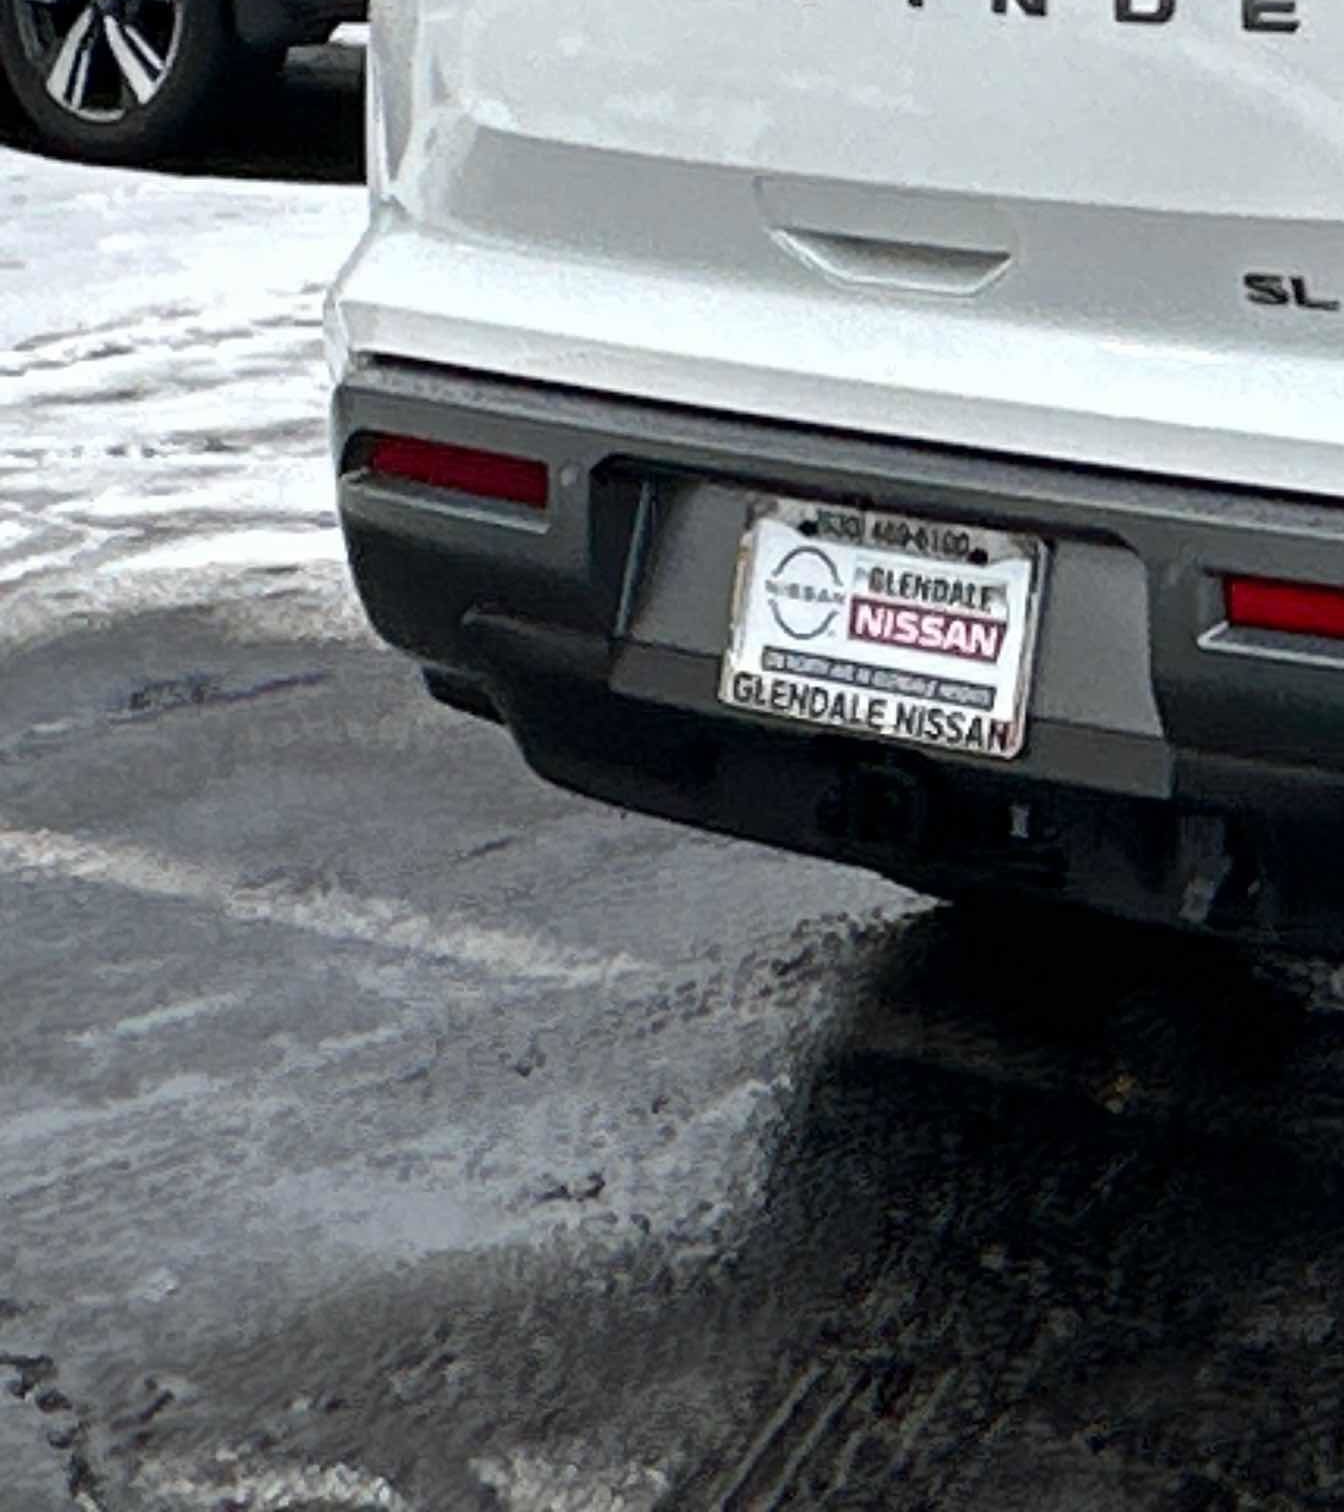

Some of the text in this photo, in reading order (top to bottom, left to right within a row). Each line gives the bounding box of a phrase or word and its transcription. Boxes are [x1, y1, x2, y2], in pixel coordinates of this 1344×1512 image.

[1243, 273, 1341, 311] SL
[765, 577, 847, 605] NISSAN
[868, 566, 993, 613] GLENDALE
[855, 604, 998, 658] NISSAN
[733, 672, 888, 727] GLENDALE
[895, 702, 1012, 752] NISSAN
